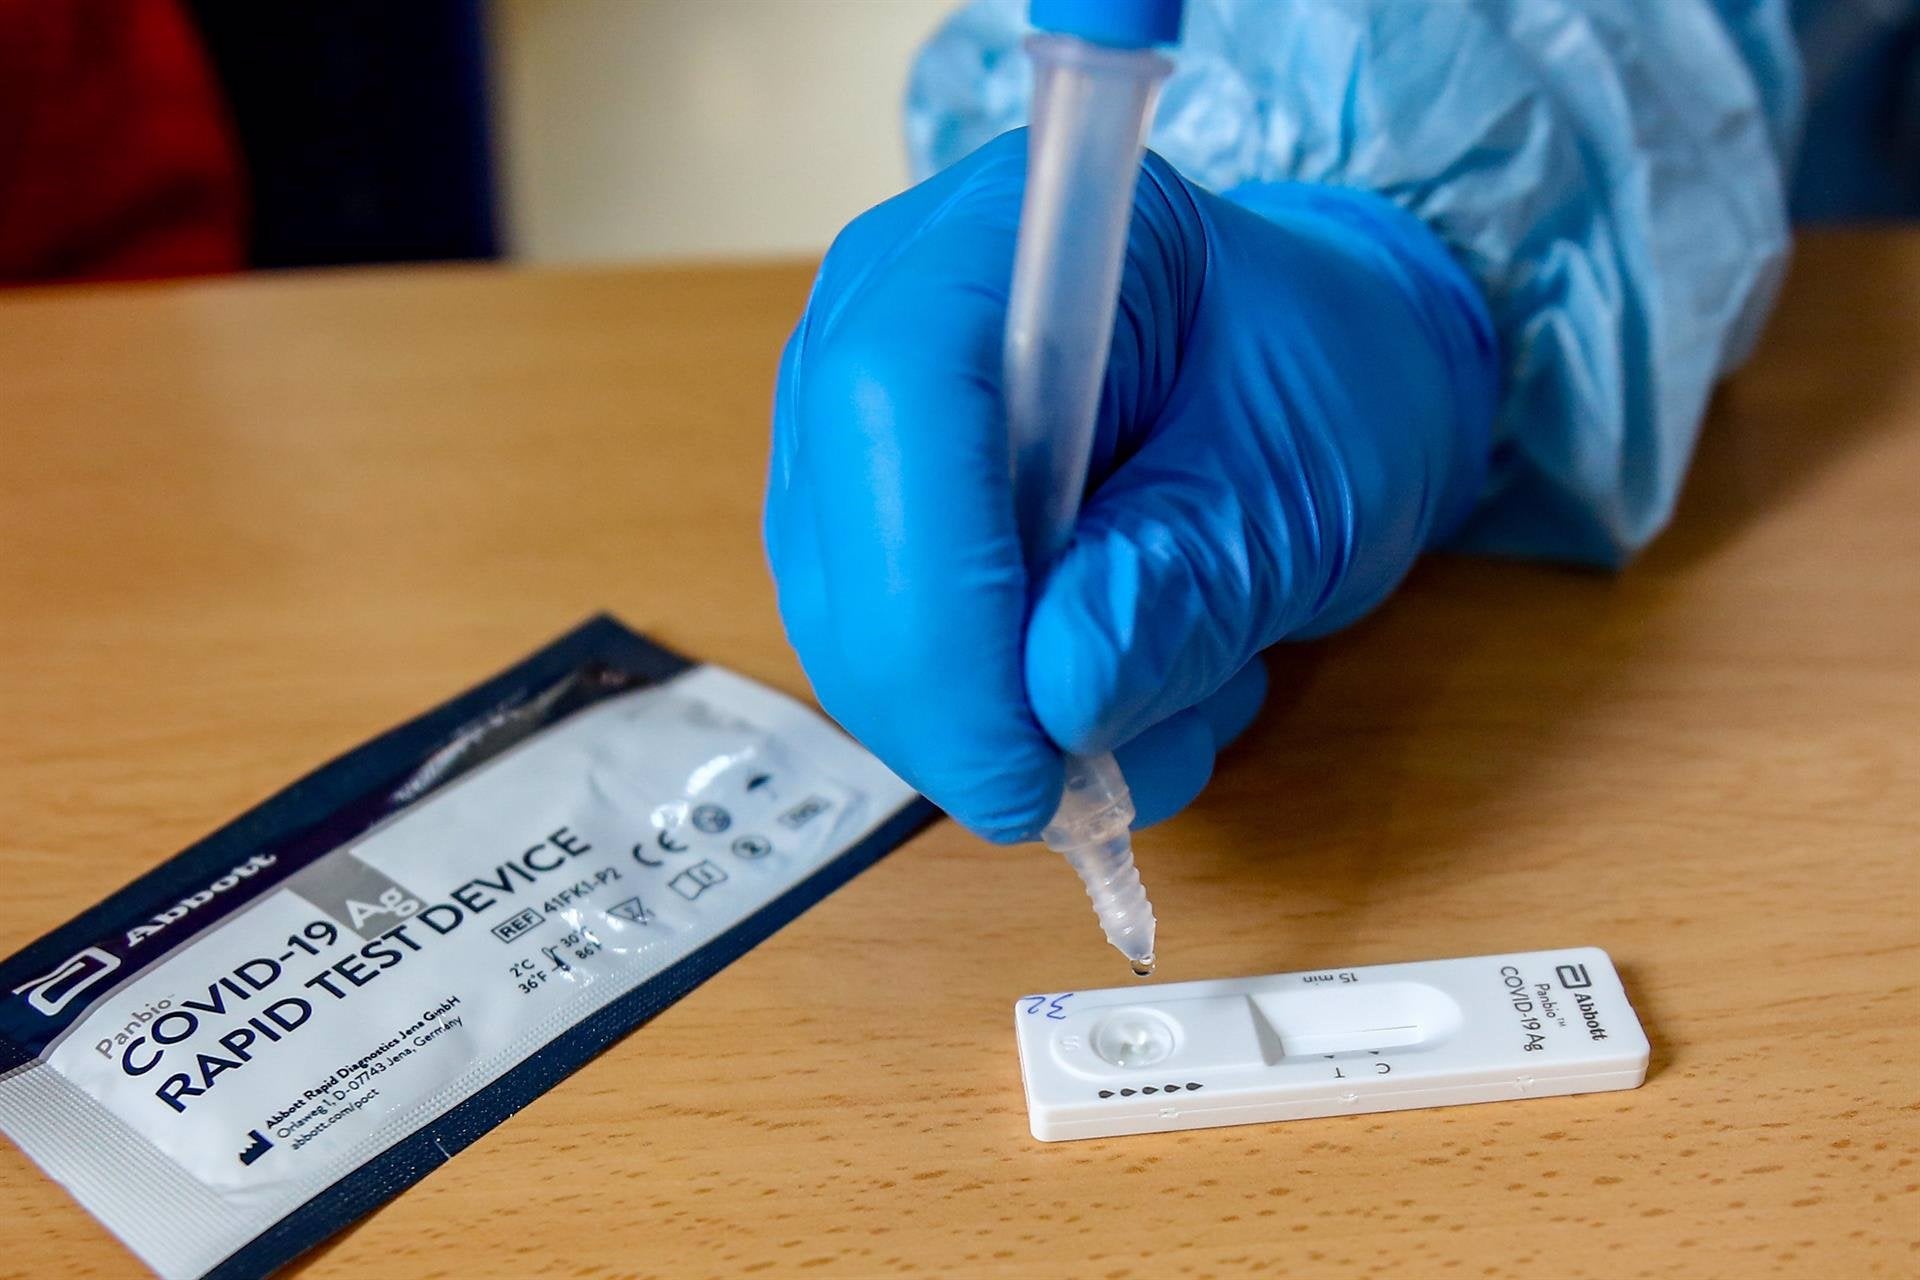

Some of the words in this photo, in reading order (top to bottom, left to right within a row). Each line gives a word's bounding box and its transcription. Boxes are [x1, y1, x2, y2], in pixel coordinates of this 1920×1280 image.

[125, 853, 278, 947] Abbott
[499, 912, 536, 939] REF
[121, 919, 338, 1077] COVID-19
[345, 886, 420, 929] Ag
[155, 997, 313, 1114] RAPID
[304, 924, 423, 1000] TEST
[416, 826, 593, 935] DEVICE
[1302, 974, 1335, 986] min
[1338, 972, 1359, 984] 15
[1023, 992, 1074, 1020] 32
[1500, 965, 1541, 1031] COVID-19
[1523, 1032, 1546, 1052] Ag
[1574, 992, 1609, 1041] Abbott
[266, 1099, 307, 1130] Abbott
[303, 1075, 340, 1101] Rapid
[336, 1038, 401, 1080] Diagnostics
[398, 1020, 425, 1040] Jena
[423, 995, 462, 1022] GmbH
[277, 1105, 328, 1139] Orlaweg
[332, 1062, 387, 1101] D-07743
[386, 1048, 417, 1067] Jena,
[413, 1015, 463, 1047] Germany
[1333, 1066, 1346, 1079] T
[1375, 1062, 1391, 1075] C
[291, 1089, 380, 1150] abbott.com/poct
